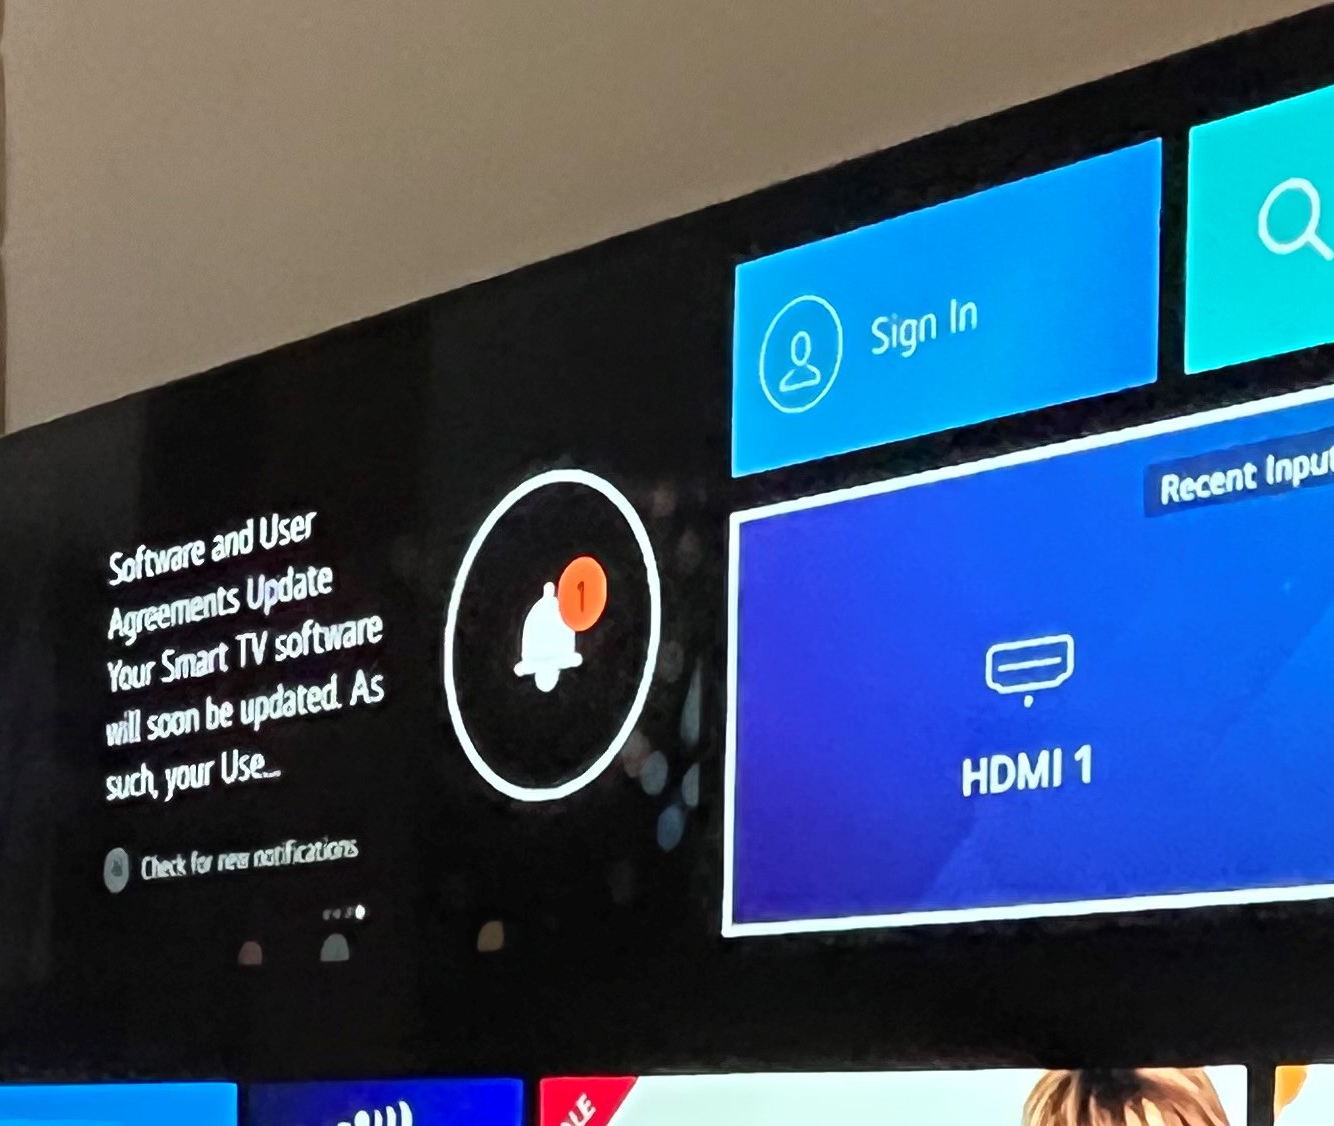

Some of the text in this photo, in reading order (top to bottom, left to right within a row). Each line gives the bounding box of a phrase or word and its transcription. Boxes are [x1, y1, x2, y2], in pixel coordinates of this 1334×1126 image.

[871, 299, 978, 358] Sign In
[1161, 462, 1258, 505] Recent
[108, 512, 317, 586] Software and User
[107, 566, 333, 646] Agreements Update
[577, 580, 585, 613] 1
[107, 615, 384, 693] Your Smart TV software
[106, 669, 385, 747] will soon be updated. As
[106, 762, 159, 801] such,
[164, 759, 215, 802] your
[962, 744, 1092, 797] HDMI 1
[141, 837, 359, 880] Check for new notifications
